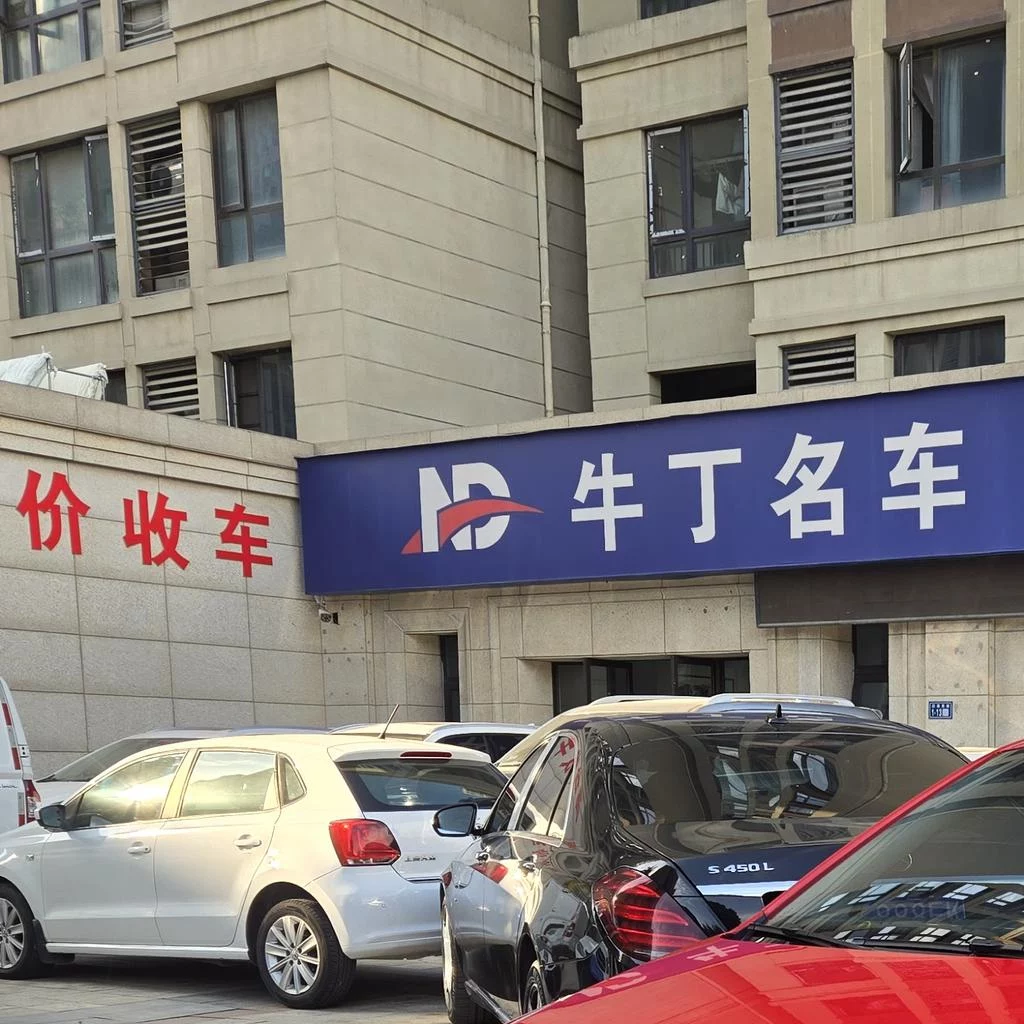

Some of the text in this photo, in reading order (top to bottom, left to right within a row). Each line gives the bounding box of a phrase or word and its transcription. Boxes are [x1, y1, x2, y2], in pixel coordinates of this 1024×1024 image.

[16, 468, 273, 578] 价收车
[571, 422, 966, 552] 牛丁名车
